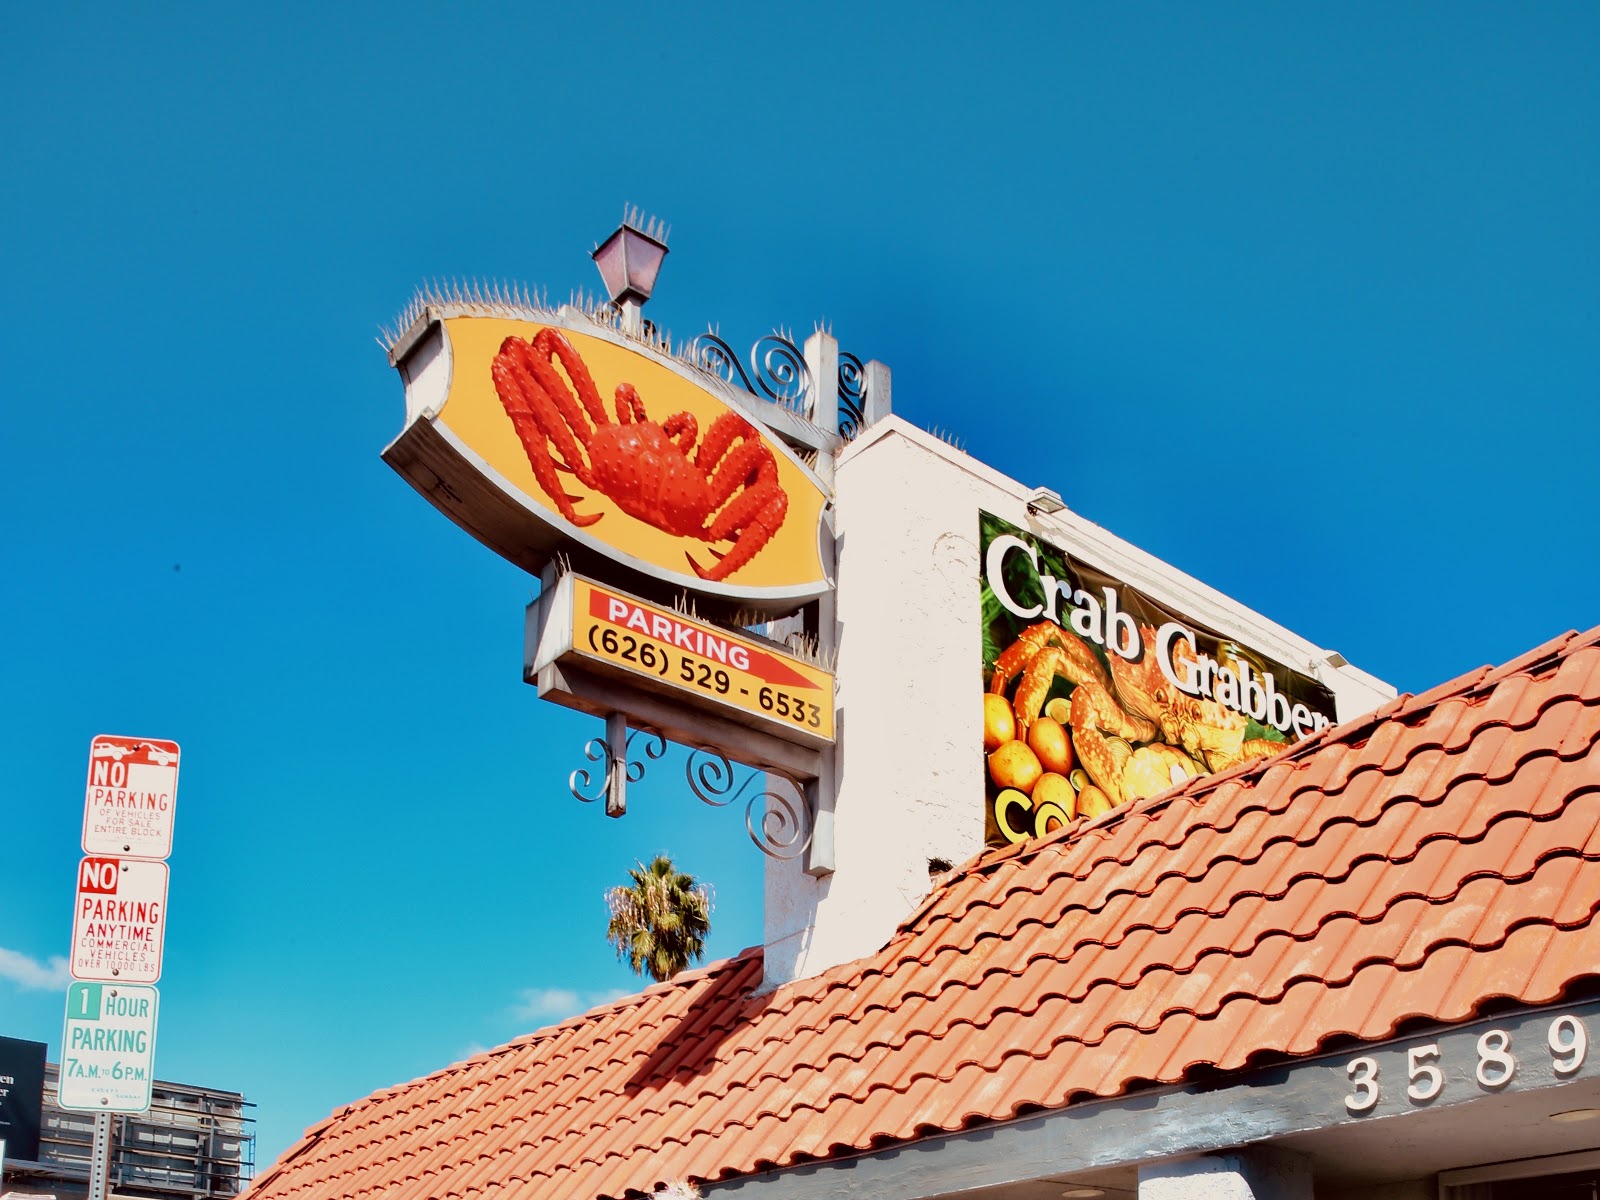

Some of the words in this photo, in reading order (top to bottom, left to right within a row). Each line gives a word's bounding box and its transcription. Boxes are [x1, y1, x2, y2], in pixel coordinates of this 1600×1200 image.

[608, 597, 749, 670] PARKING
[986, 534, 1143, 659] Crab
[1155, 623, 1338, 740] Grabber
[588, 624, 669, 675] (626)
[680, 656, 730, 694] 529
[758, 687, 821, 727] 6533
[93, 760, 126, 787] NO
[94, 788, 168, 811] PARKING
[99, 808, 111, 816] OF
[115, 810, 161, 820] VEHICLES
[106, 817, 125, 825] FOR
[128, 818, 152, 828] SALE
[94, 824, 127, 835] ENTIRE
[131, 827, 162, 837] BLOCK
[82, 861, 117, 890] NO
[82, 898, 159, 924] PARKING
[85, 923, 154, 942] ANYTIME
[81, 938, 156, 952] COMMERCIAL
[90, 949, 146, 962] VEHICLES
[78, 958, 100, 968] OVER
[138, 963, 155, 972] LBS
[80, 986, 89, 1015] 1
[105, 996, 149, 1018] HOUR
[71, 1027, 147, 1054] PARKING
[101, 1068, 110, 1076] TO
[1344, 1014, 1587, 1111] 3589
